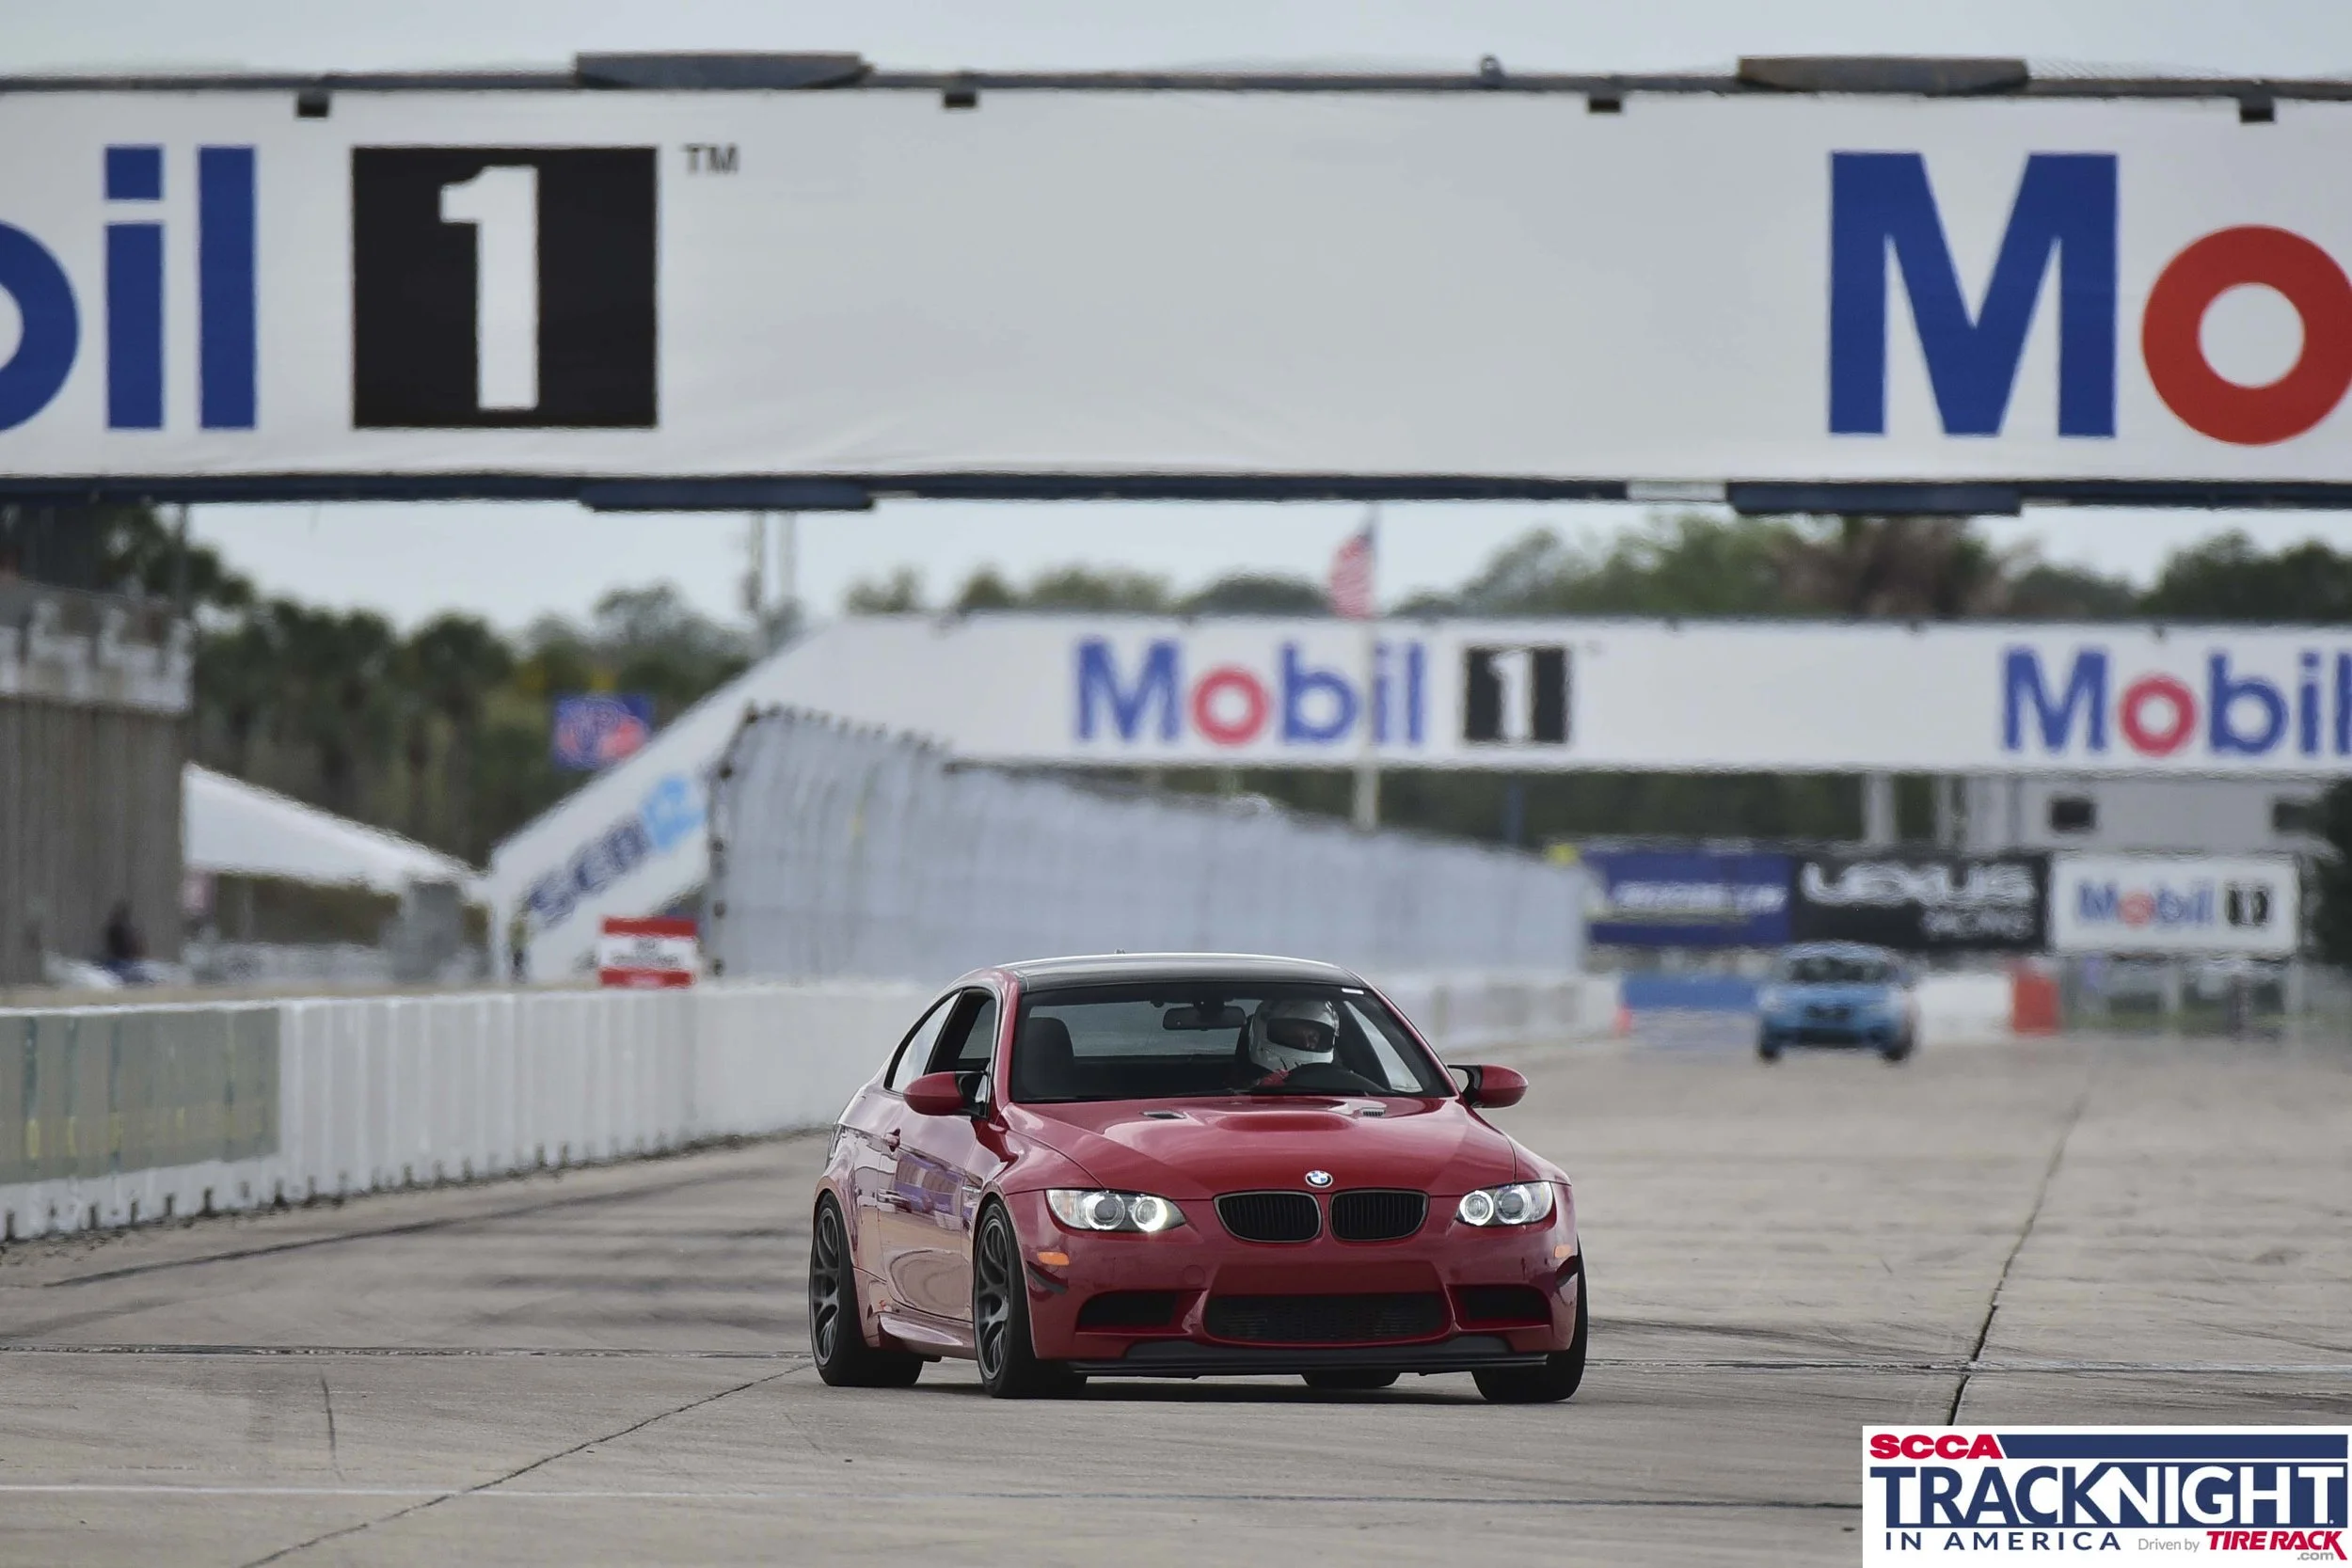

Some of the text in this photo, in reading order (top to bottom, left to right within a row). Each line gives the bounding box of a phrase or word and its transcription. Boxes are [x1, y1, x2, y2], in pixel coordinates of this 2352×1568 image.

[440, 165, 540, 412] 1
[1828, 150, 2352, 446] Mo
[1073, 636, 1426, 747] Mobil
[2002, 645, 2352, 755] Mobil
[2077, 879, 2215, 929] Mobil
